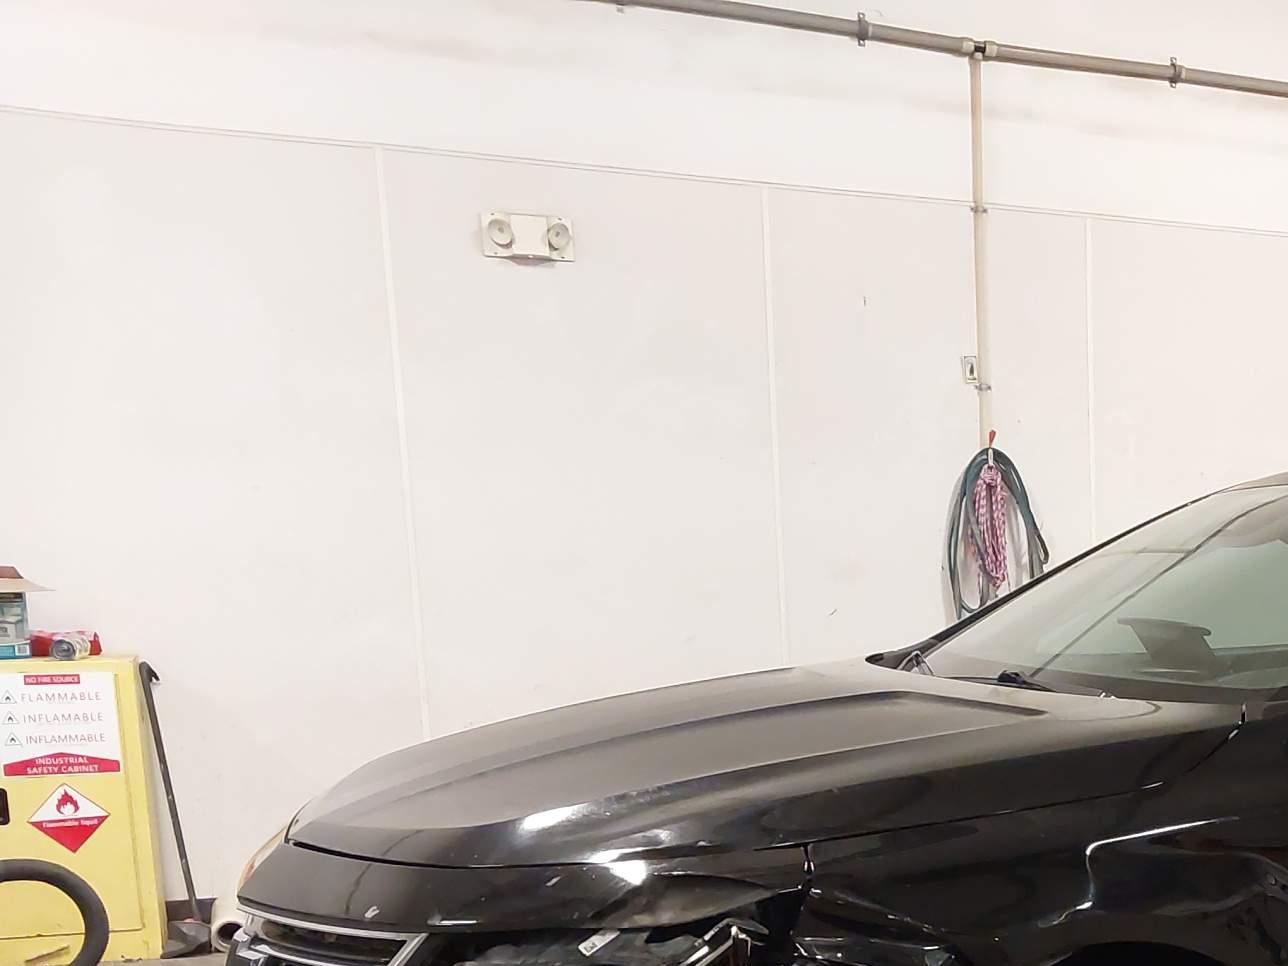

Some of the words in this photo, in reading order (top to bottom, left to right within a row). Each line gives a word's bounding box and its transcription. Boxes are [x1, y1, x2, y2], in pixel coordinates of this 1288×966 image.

[20, 691, 102, 702] FLAMMABLE
[23, 712, 104, 723] INFLAMABLE
[25, 733, 106, 745] INFLAMMABLE
[35, 757, 88, 765] INDUSTRIAL
[26, 767, 58, 775] SAFETY
[61, 764, 99, 774] CABINET
